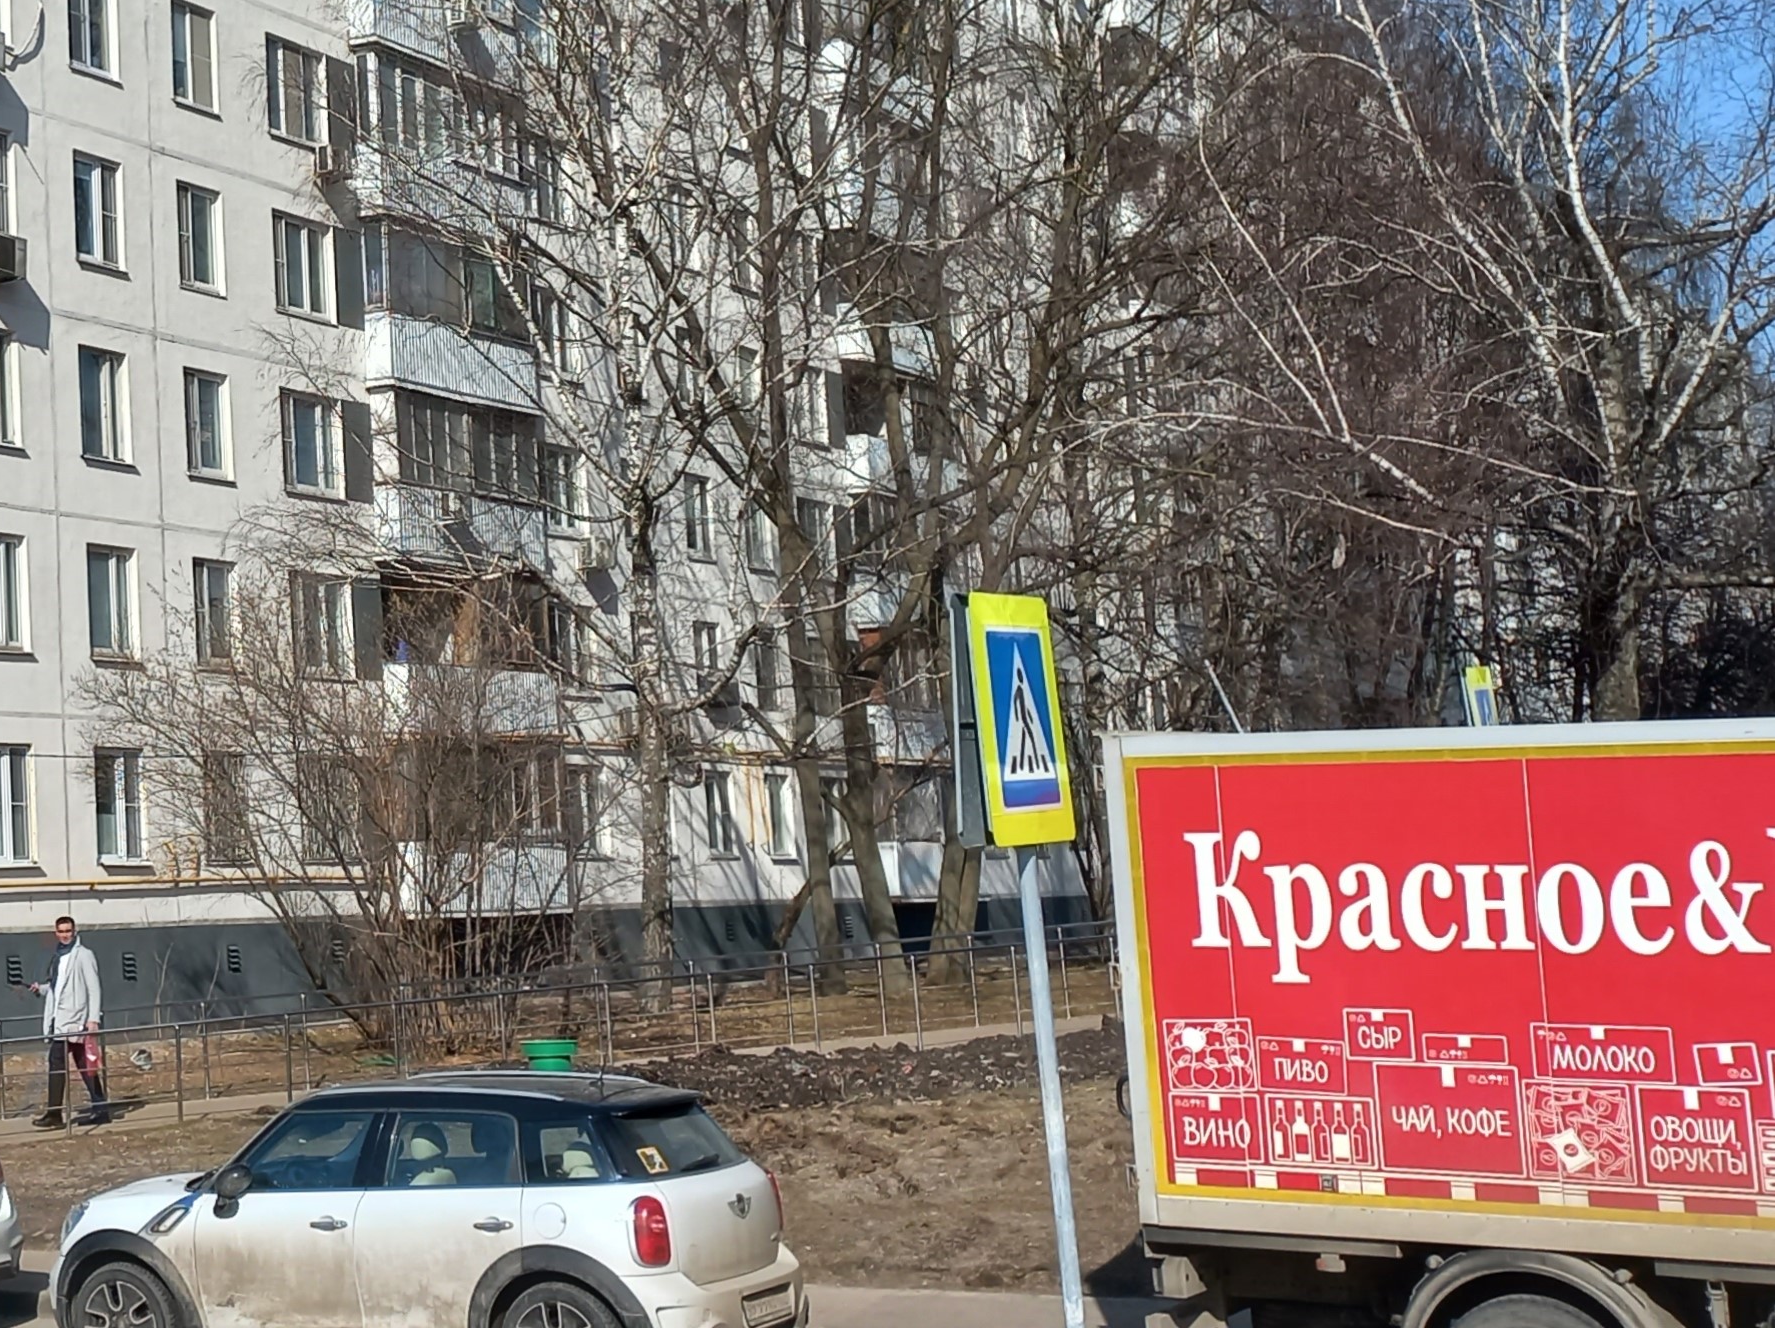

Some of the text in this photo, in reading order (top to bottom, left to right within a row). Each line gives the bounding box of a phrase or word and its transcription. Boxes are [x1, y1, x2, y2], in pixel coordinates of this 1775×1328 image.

[1182, 827, 1775, 984] Красное&
[1357, 1025, 1403, 1050] СЫР
[1273, 1057, 1329, 1083] ПИВО
[1552, 1044, 1656, 1073] МОЛОКО
[1182, 1116, 1252, 1149] ВИНО
[1391, 1104, 1512, 1139] ЧАЙ, КОФЕ
[1650, 1115, 1743, 1151] ОВОЩИ,
[1649, 1143, 1749, 1176] ФРУКТЫ
